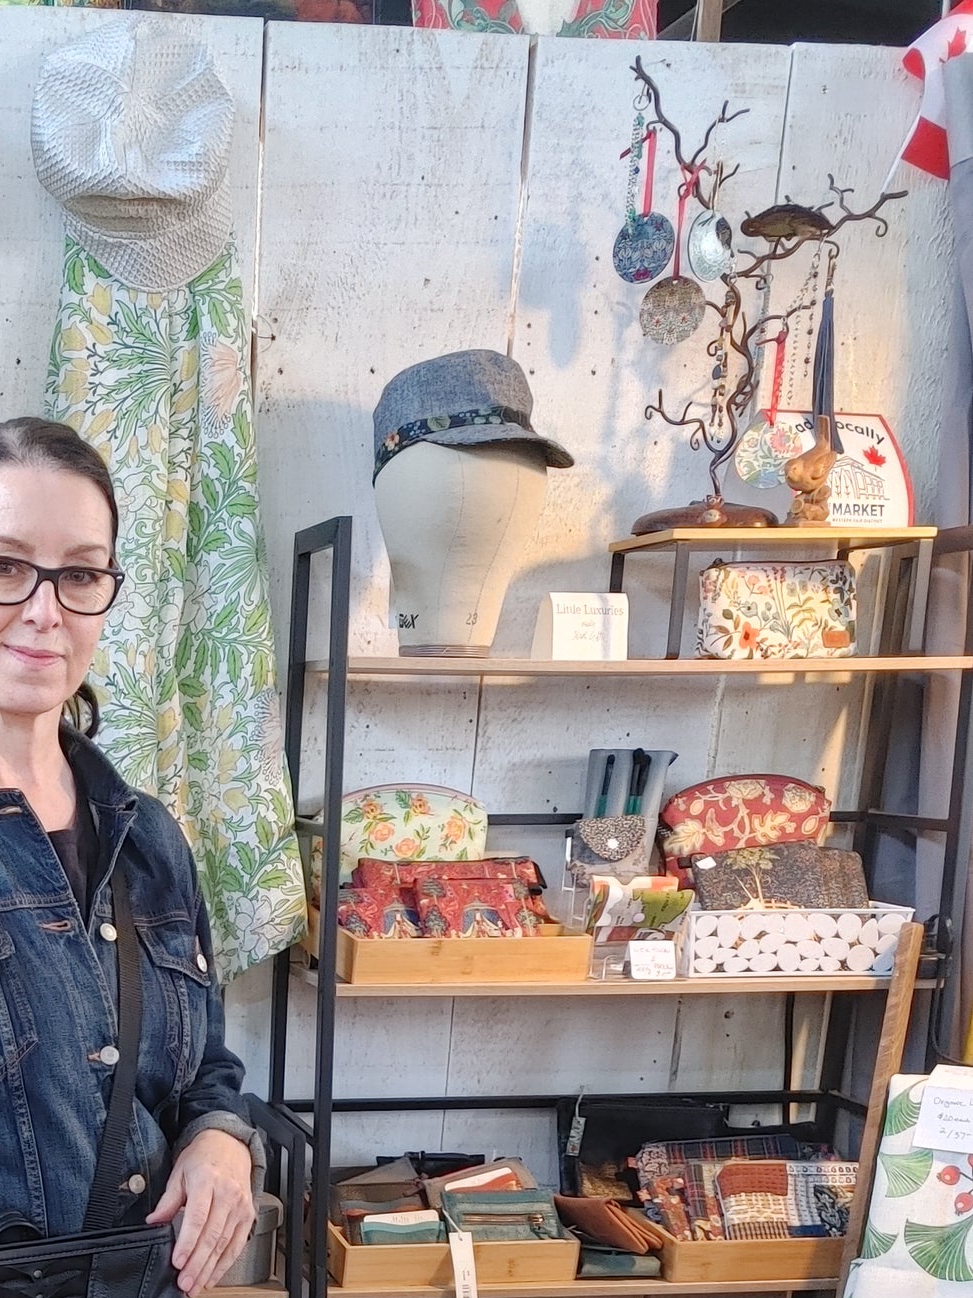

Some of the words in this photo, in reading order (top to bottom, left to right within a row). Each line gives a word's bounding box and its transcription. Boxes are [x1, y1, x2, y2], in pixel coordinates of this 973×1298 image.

[835, 421, 885, 445] ocally
[832, 503, 885, 518] MARKET
[556, 603, 581, 615] Little
[584, 604, 624, 616] Luxuries
